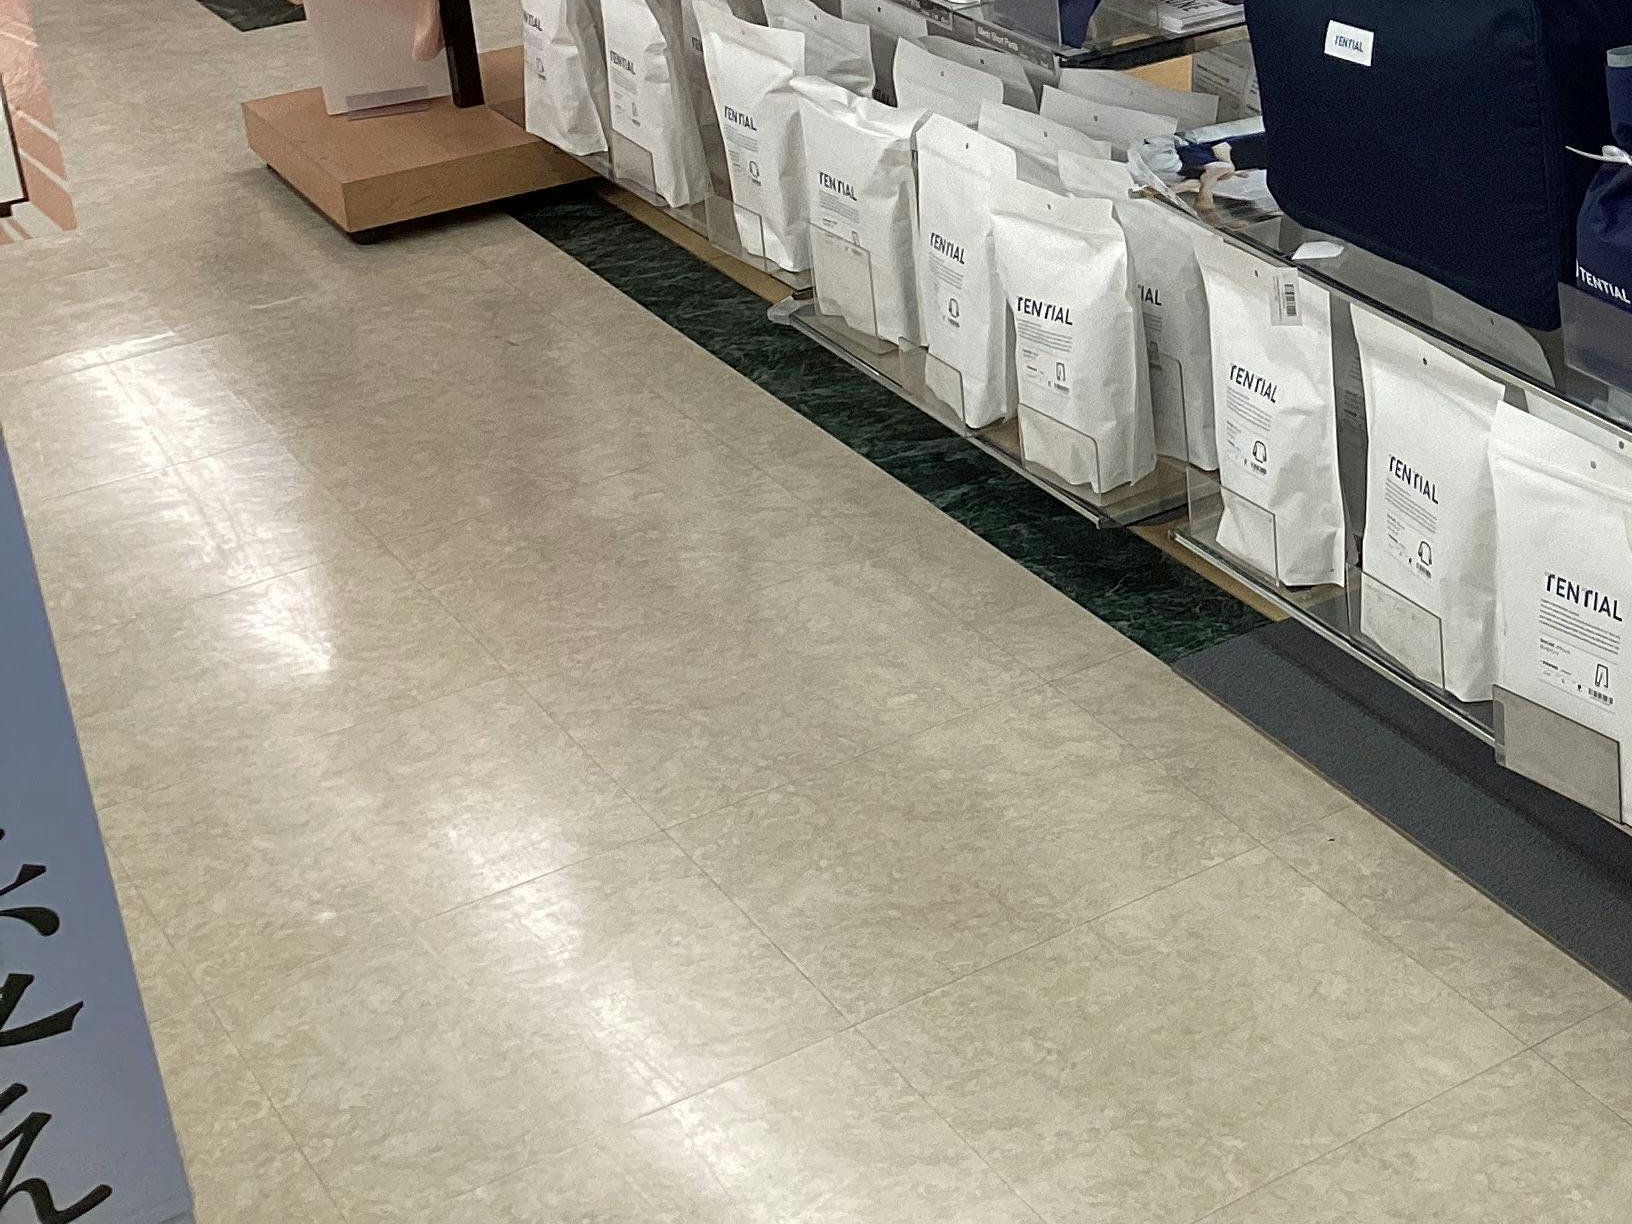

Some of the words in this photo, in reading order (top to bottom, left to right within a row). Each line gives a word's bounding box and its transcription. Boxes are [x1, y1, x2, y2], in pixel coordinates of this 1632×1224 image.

[1334, 34, 1364, 54] TENTIAL
[610, 50, 636, 75] TENTIAL
[724, 105, 757, 131] TENTIAL
[819, 171, 858, 201] TENTIAL
[930, 232, 965, 265] TENTIAL
[1578, 264, 1631, 305] TENTIAL
[1017, 295, 1073, 326] TENTIAL
[1229, 363, 1278, 404] TENTIAL
[1387, 454, 1439, 506] TENTIAL
[1544, 571, 1623, 623] TENTIAL
